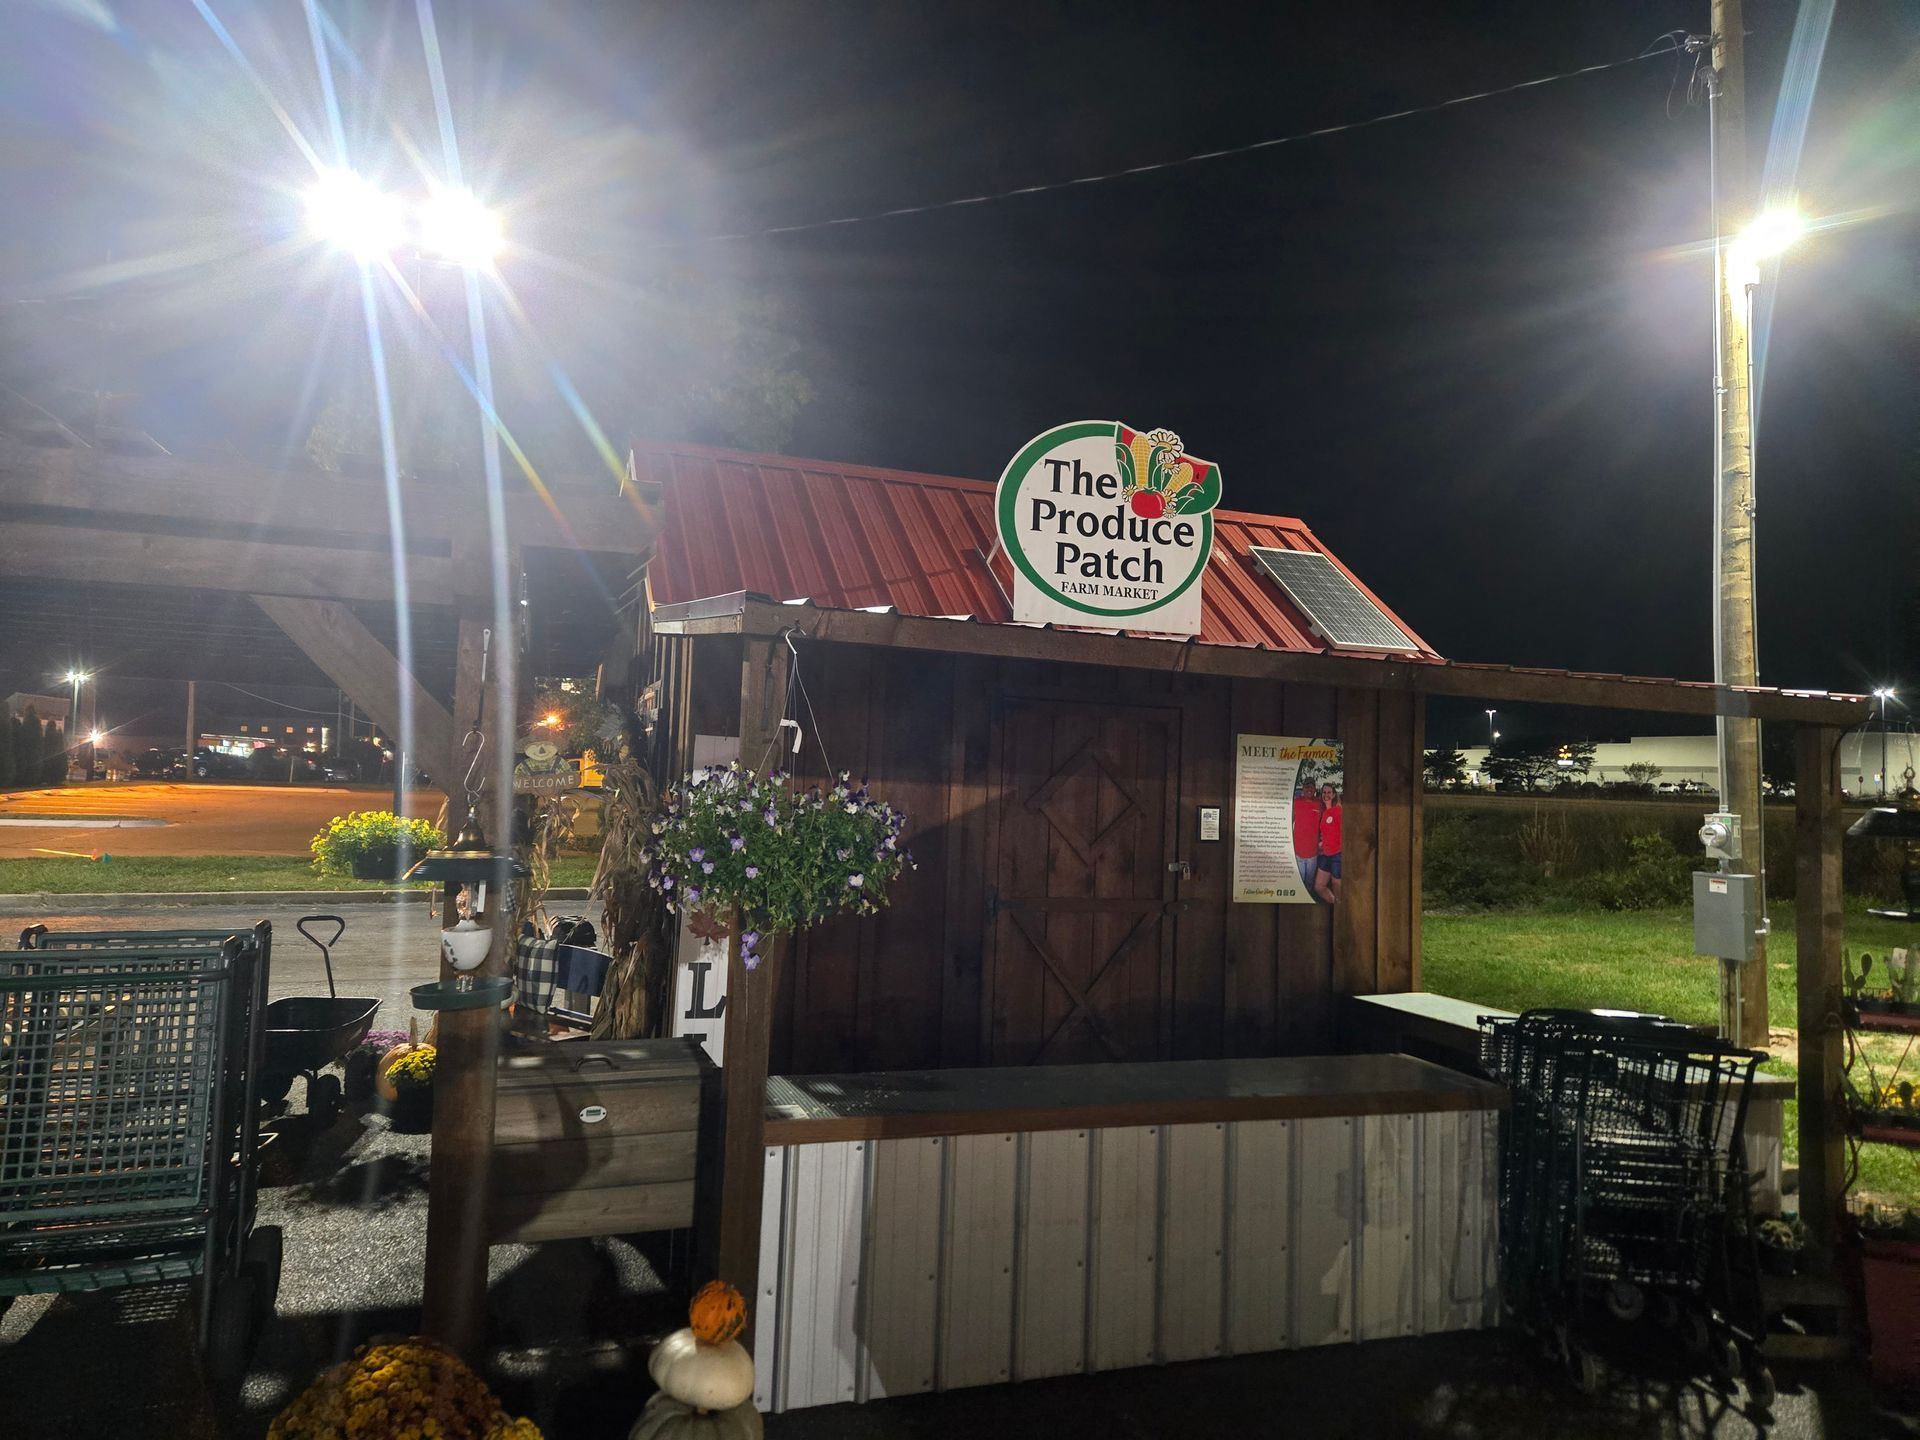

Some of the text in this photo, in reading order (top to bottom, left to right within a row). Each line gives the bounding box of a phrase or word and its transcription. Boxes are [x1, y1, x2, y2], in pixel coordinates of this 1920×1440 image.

[1044, 458, 1118, 499] The
[1030, 498, 1195, 547] Produce
[1054, 541, 1165, 584] Patch
[1061, 581, 1159, 601] FARM MARKET
[1241, 745, 1334, 760] MEET the Farmers
[513, 775, 575, 789] WELCOME
